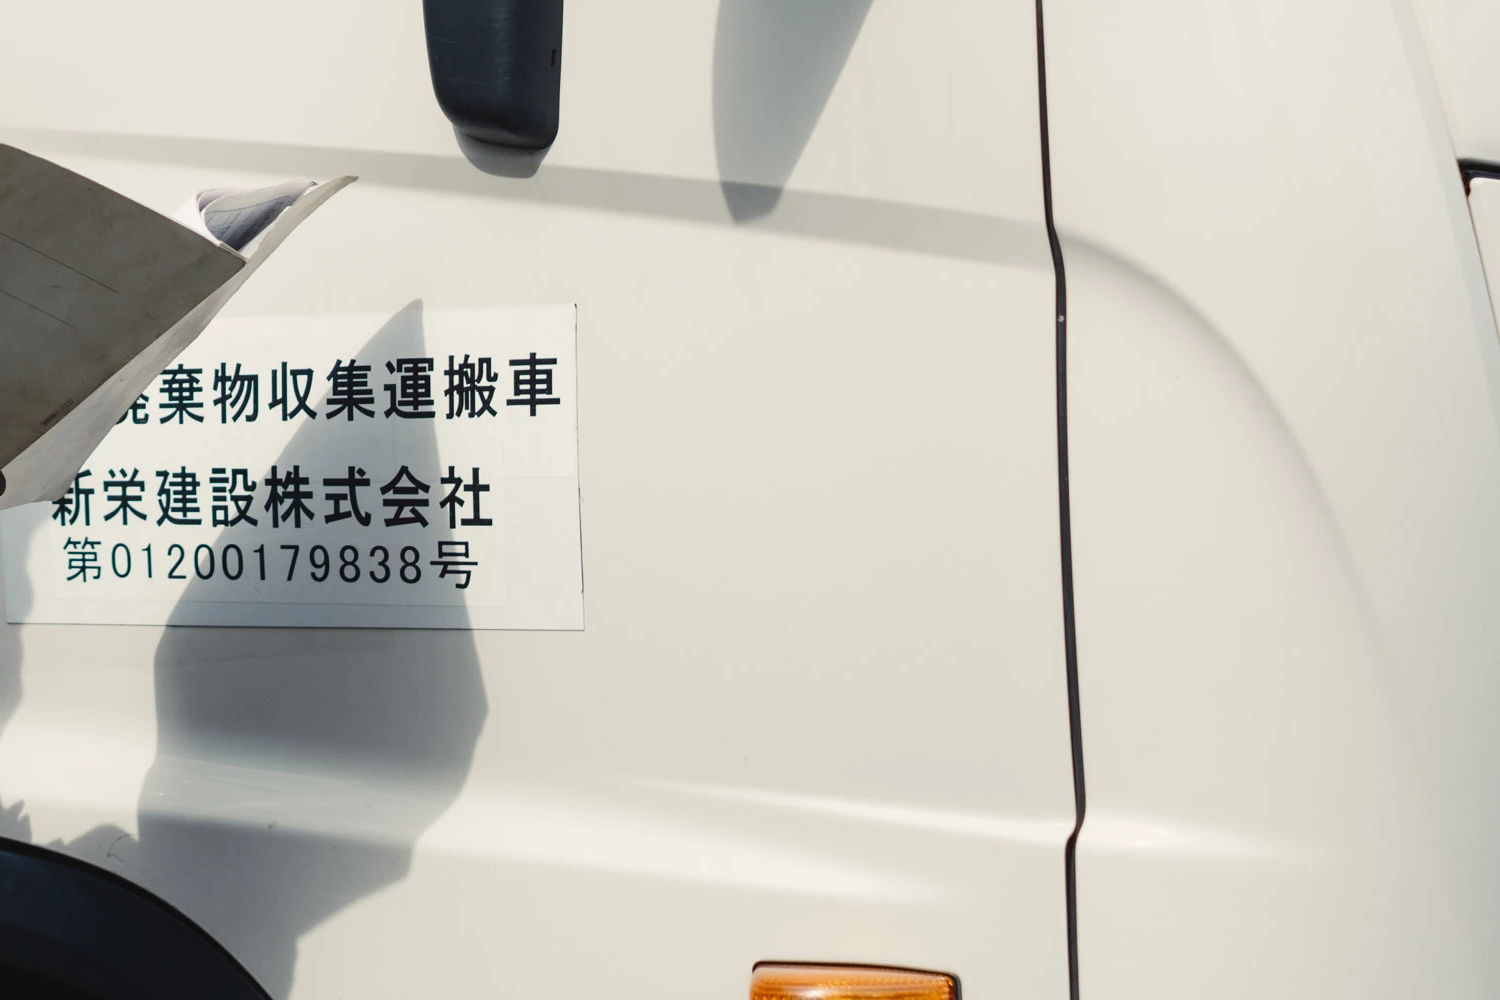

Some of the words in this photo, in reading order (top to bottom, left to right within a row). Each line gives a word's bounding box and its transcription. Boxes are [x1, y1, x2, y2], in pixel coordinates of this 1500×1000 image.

[51, 464, 494, 530] 新栄建設株式会社
[63, 536, 479, 589] 第01200179838号
